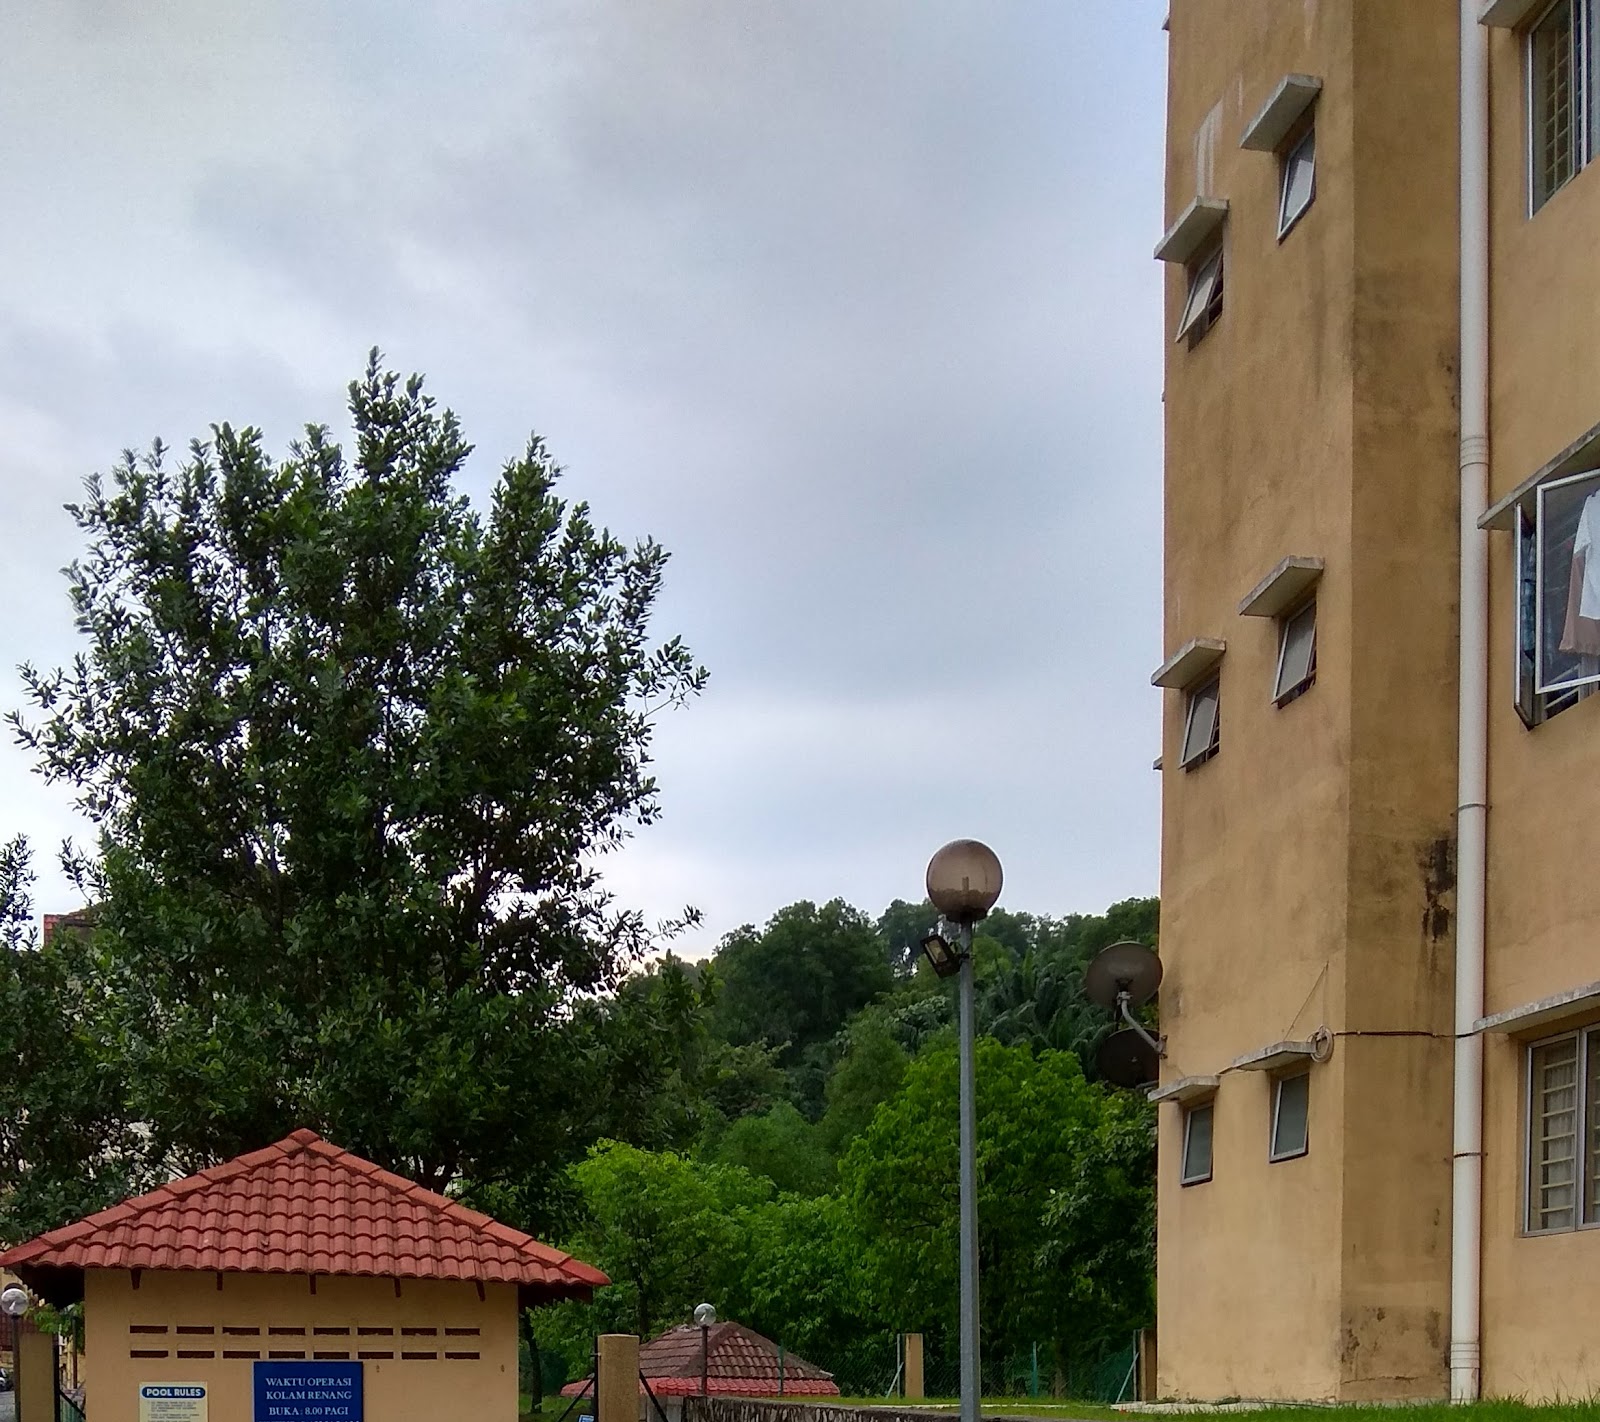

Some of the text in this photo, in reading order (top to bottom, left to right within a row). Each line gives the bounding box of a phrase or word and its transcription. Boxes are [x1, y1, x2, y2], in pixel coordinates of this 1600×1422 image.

[265, 1377, 352, 1387] WAKTU OPERASI
[146, 1388, 201, 1397] POOL RULES
[266, 1391, 352, 1400] KOLAM RENANG
[304, 1407, 322, 1416] 8.00
[324, 1407, 348, 1416] PAGI
